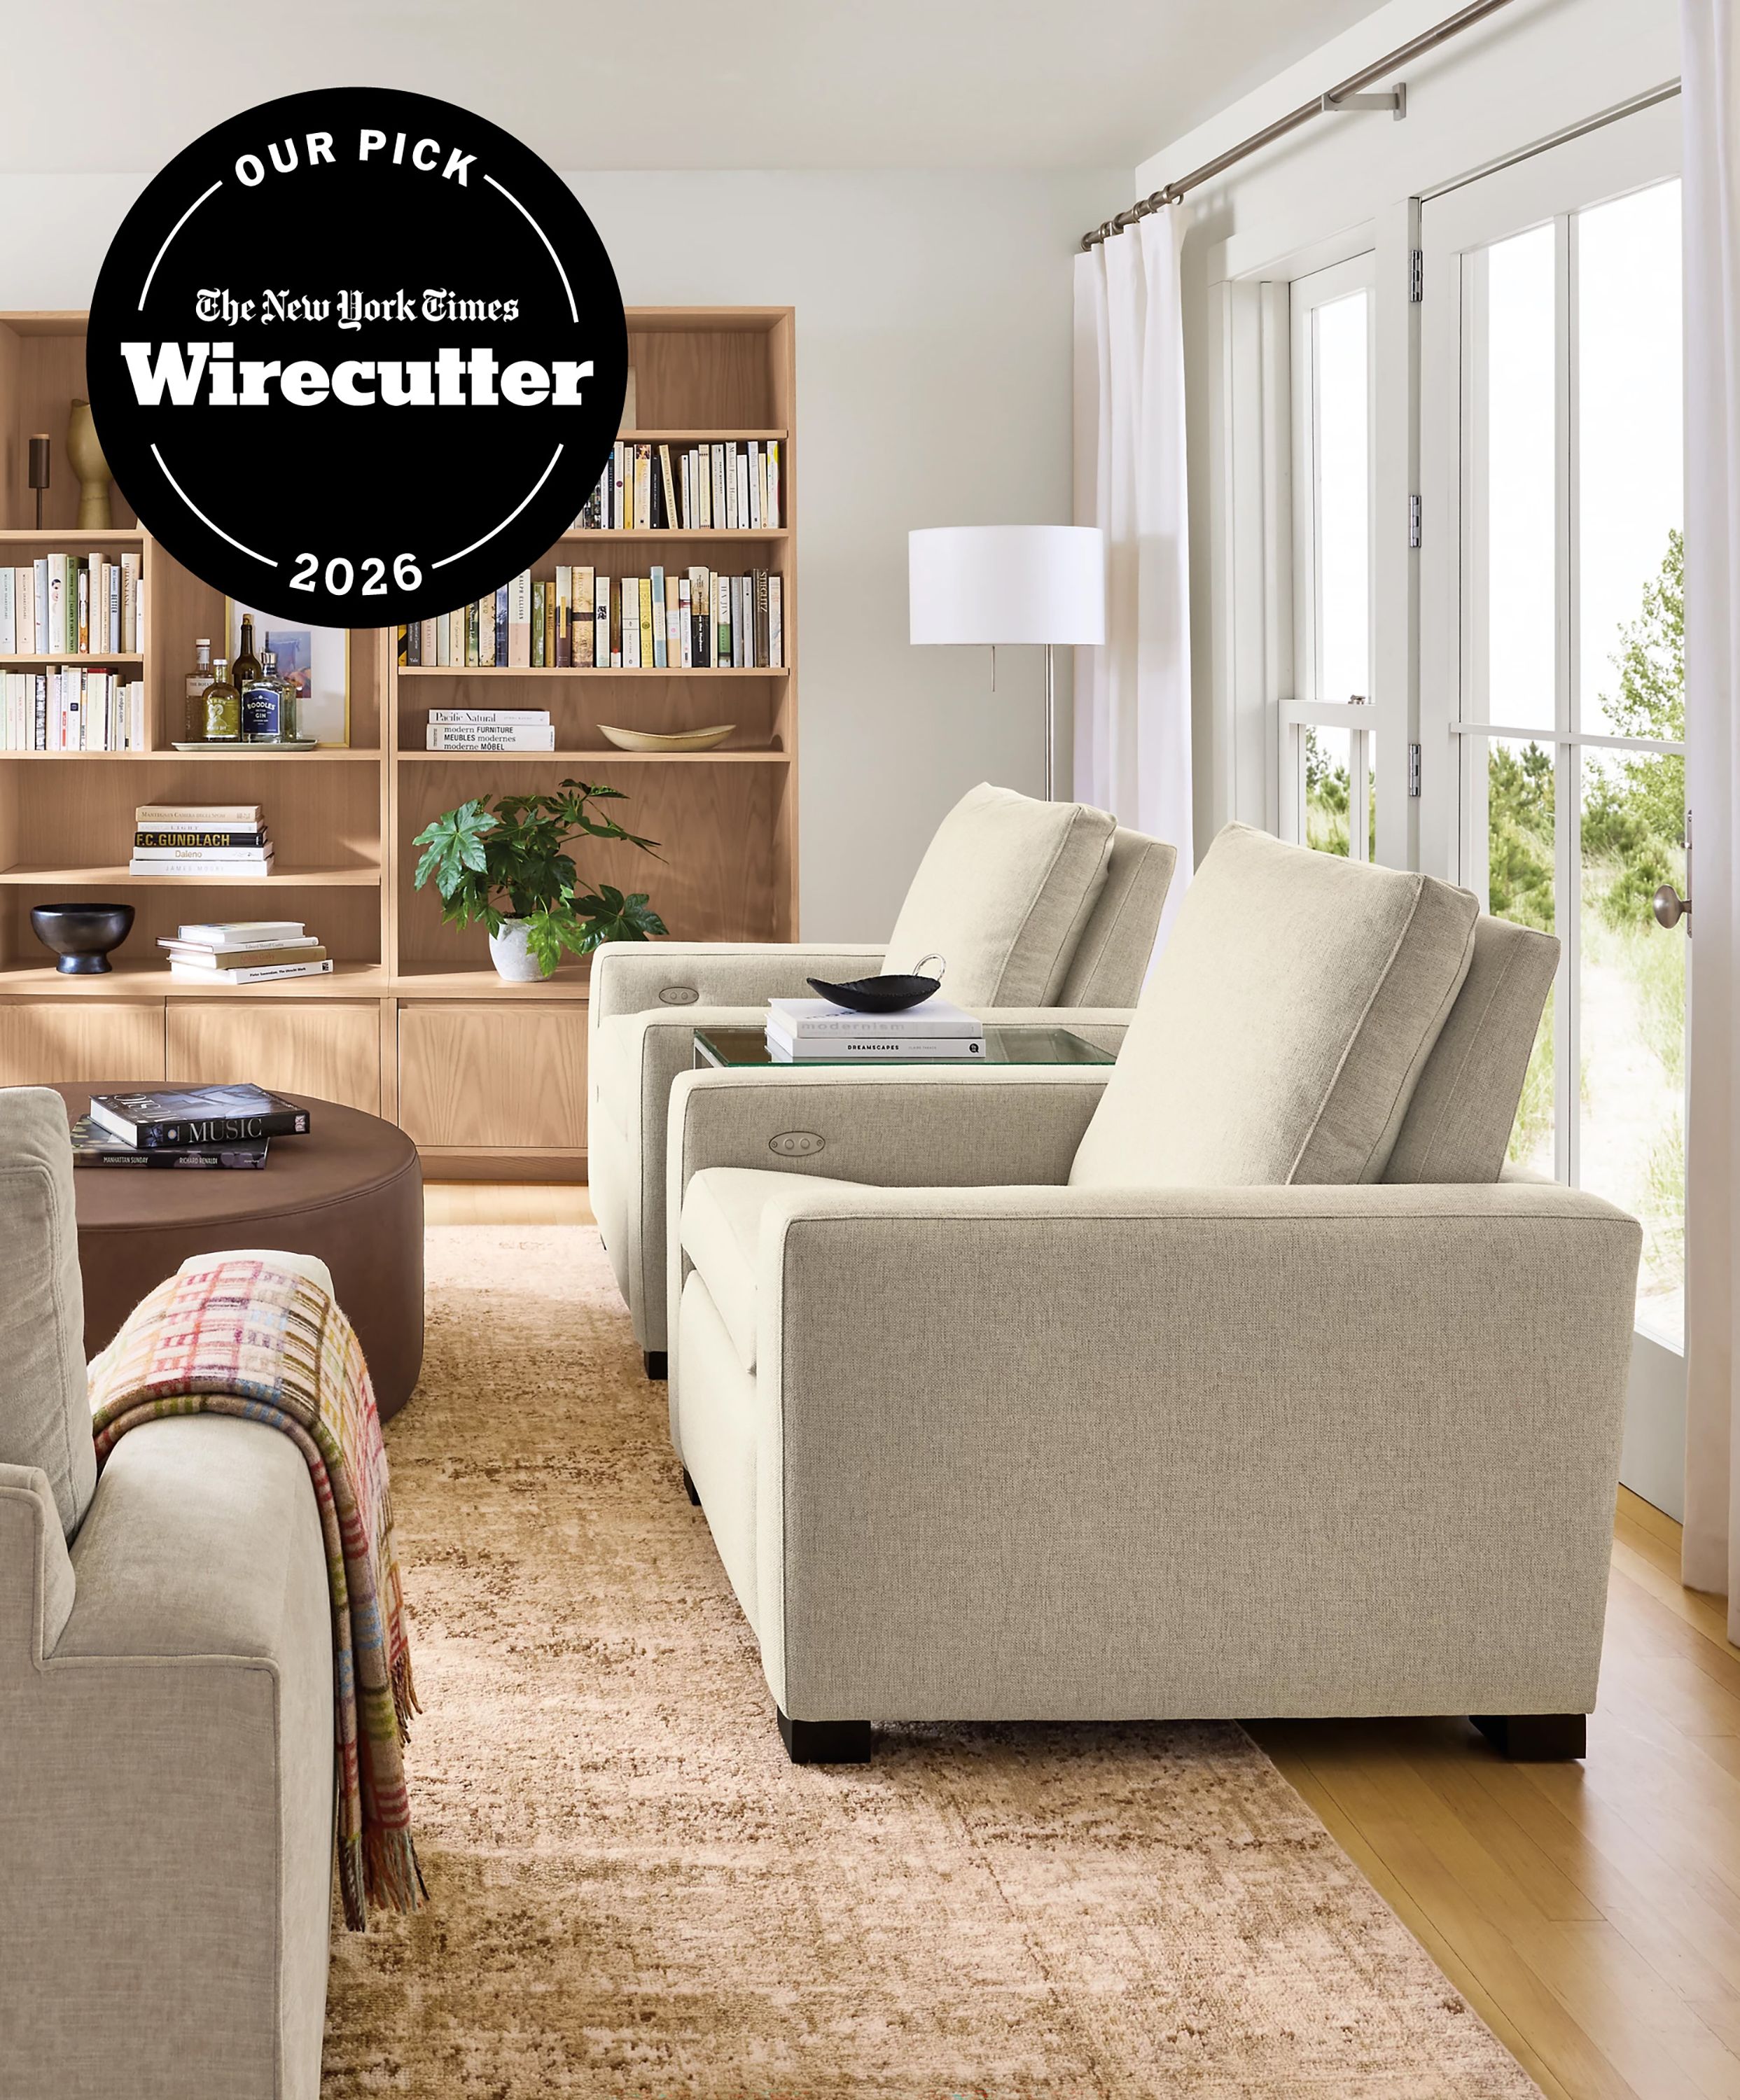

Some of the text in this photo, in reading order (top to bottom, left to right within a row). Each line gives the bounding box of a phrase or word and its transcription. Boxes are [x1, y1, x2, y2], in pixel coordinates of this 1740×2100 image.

[246, 701, 276, 710] BOODLES
[436, 712, 496, 723] Pacific Natural
[136, 834, 230, 846] F.C. GUNDLACH
[801, 1022, 904, 1031] modernism
[188, 1118, 262, 1143] MUSIC
